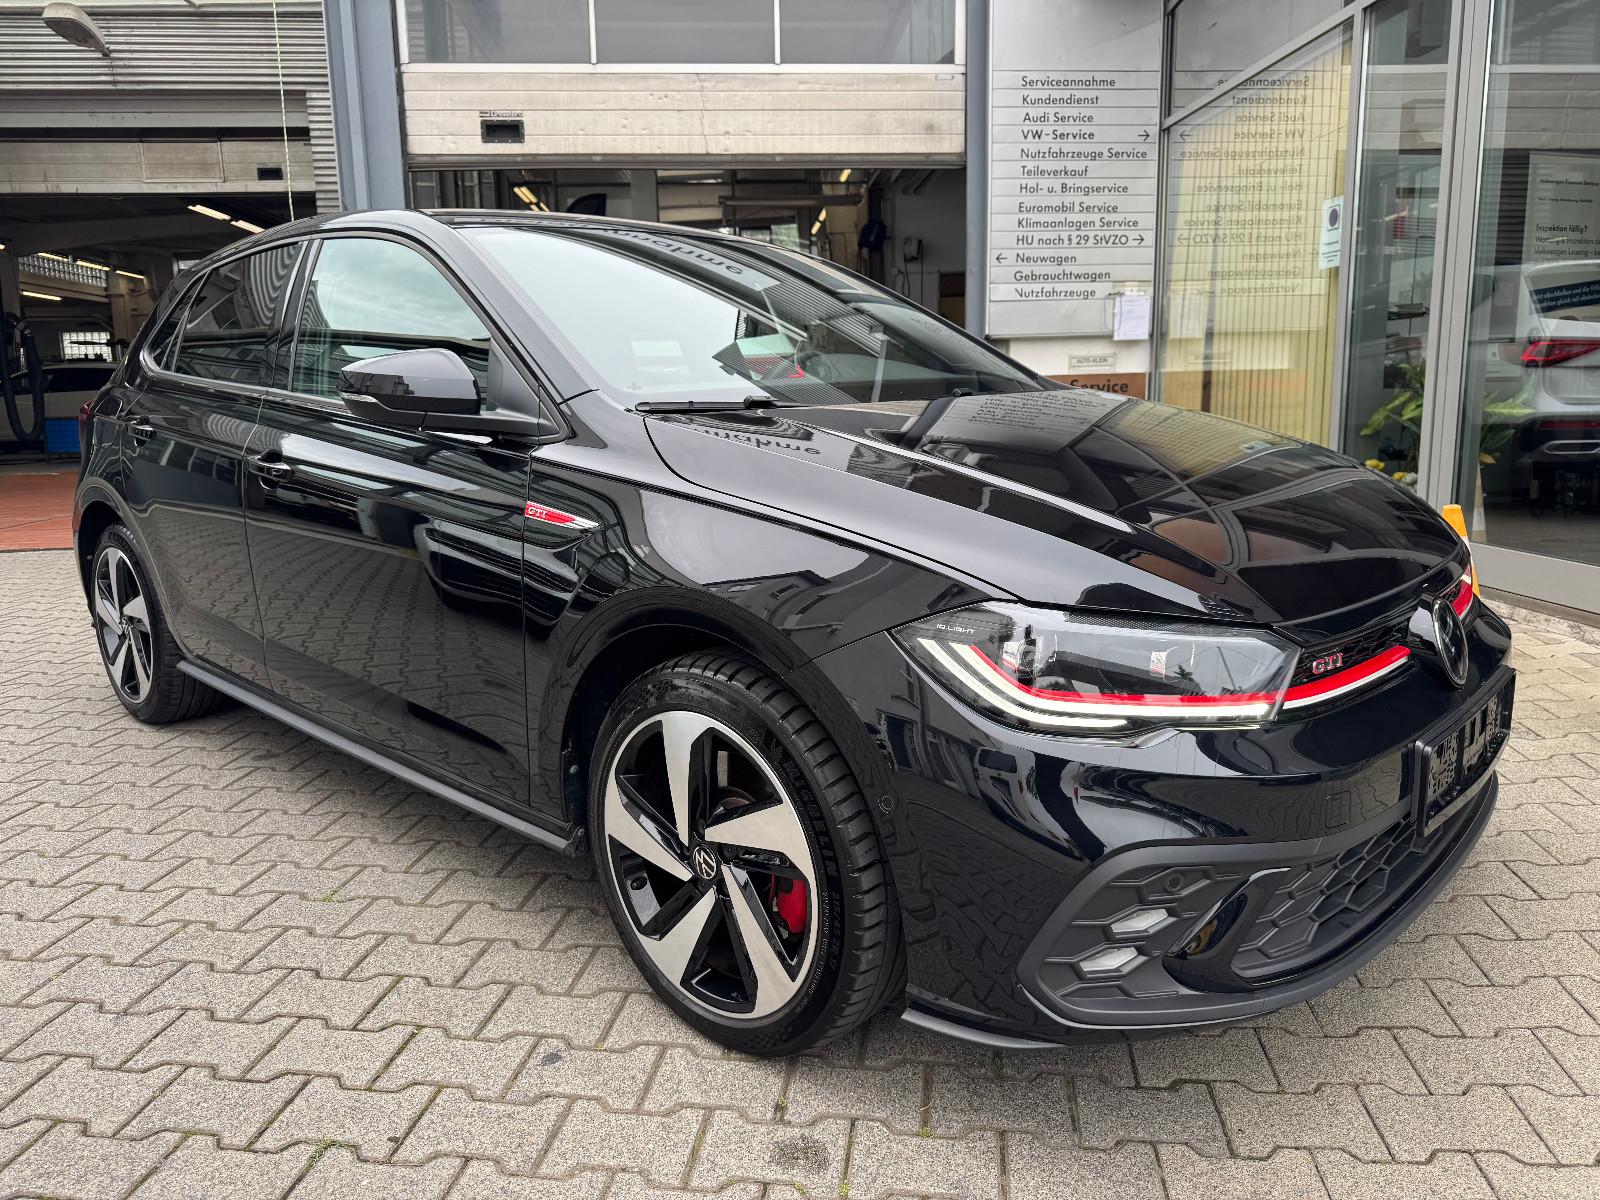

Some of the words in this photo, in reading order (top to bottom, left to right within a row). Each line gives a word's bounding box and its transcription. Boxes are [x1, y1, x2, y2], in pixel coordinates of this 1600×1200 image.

[1021, 76, 1116, 87] Serviceannahme
[1022, 94, 1100, 106] Kundendienst
[1022, 112, 1050, 123] Audi
[1053, 112, 1094, 123] Service
[1020, 147, 1104, 161] Nutzfahrzeuge
[1107, 148, 1147, 159] Service
[1020, 166, 1088, 177] Teileverkauf
[1019, 183, 1044, 194] Hol-
[1060, 182, 1128, 196] Bringservice
[1018, 202, 1075, 213] Euromobil
[1079, 202, 1118, 213] Service
[1017, 217, 1096, 231] Klimaanlagen
[1099, 217, 1139, 228] Service
[1536, 224, 1568, 233] Inspektion
[1016, 235, 1034, 246] HU
[1038, 234, 1064, 245] nach
[1067, 235, 1073, 246] §
[1075, 234, 1089, 245] 29
[1093, 234, 1128, 245] StVZO
[1015, 253, 1077, 265] Neuwagen
[1014, 269, 1111, 282] Gebrauchtwagen
[528, 507, 547, 518] GTI
[1312, 653, 1344, 675] GTI
